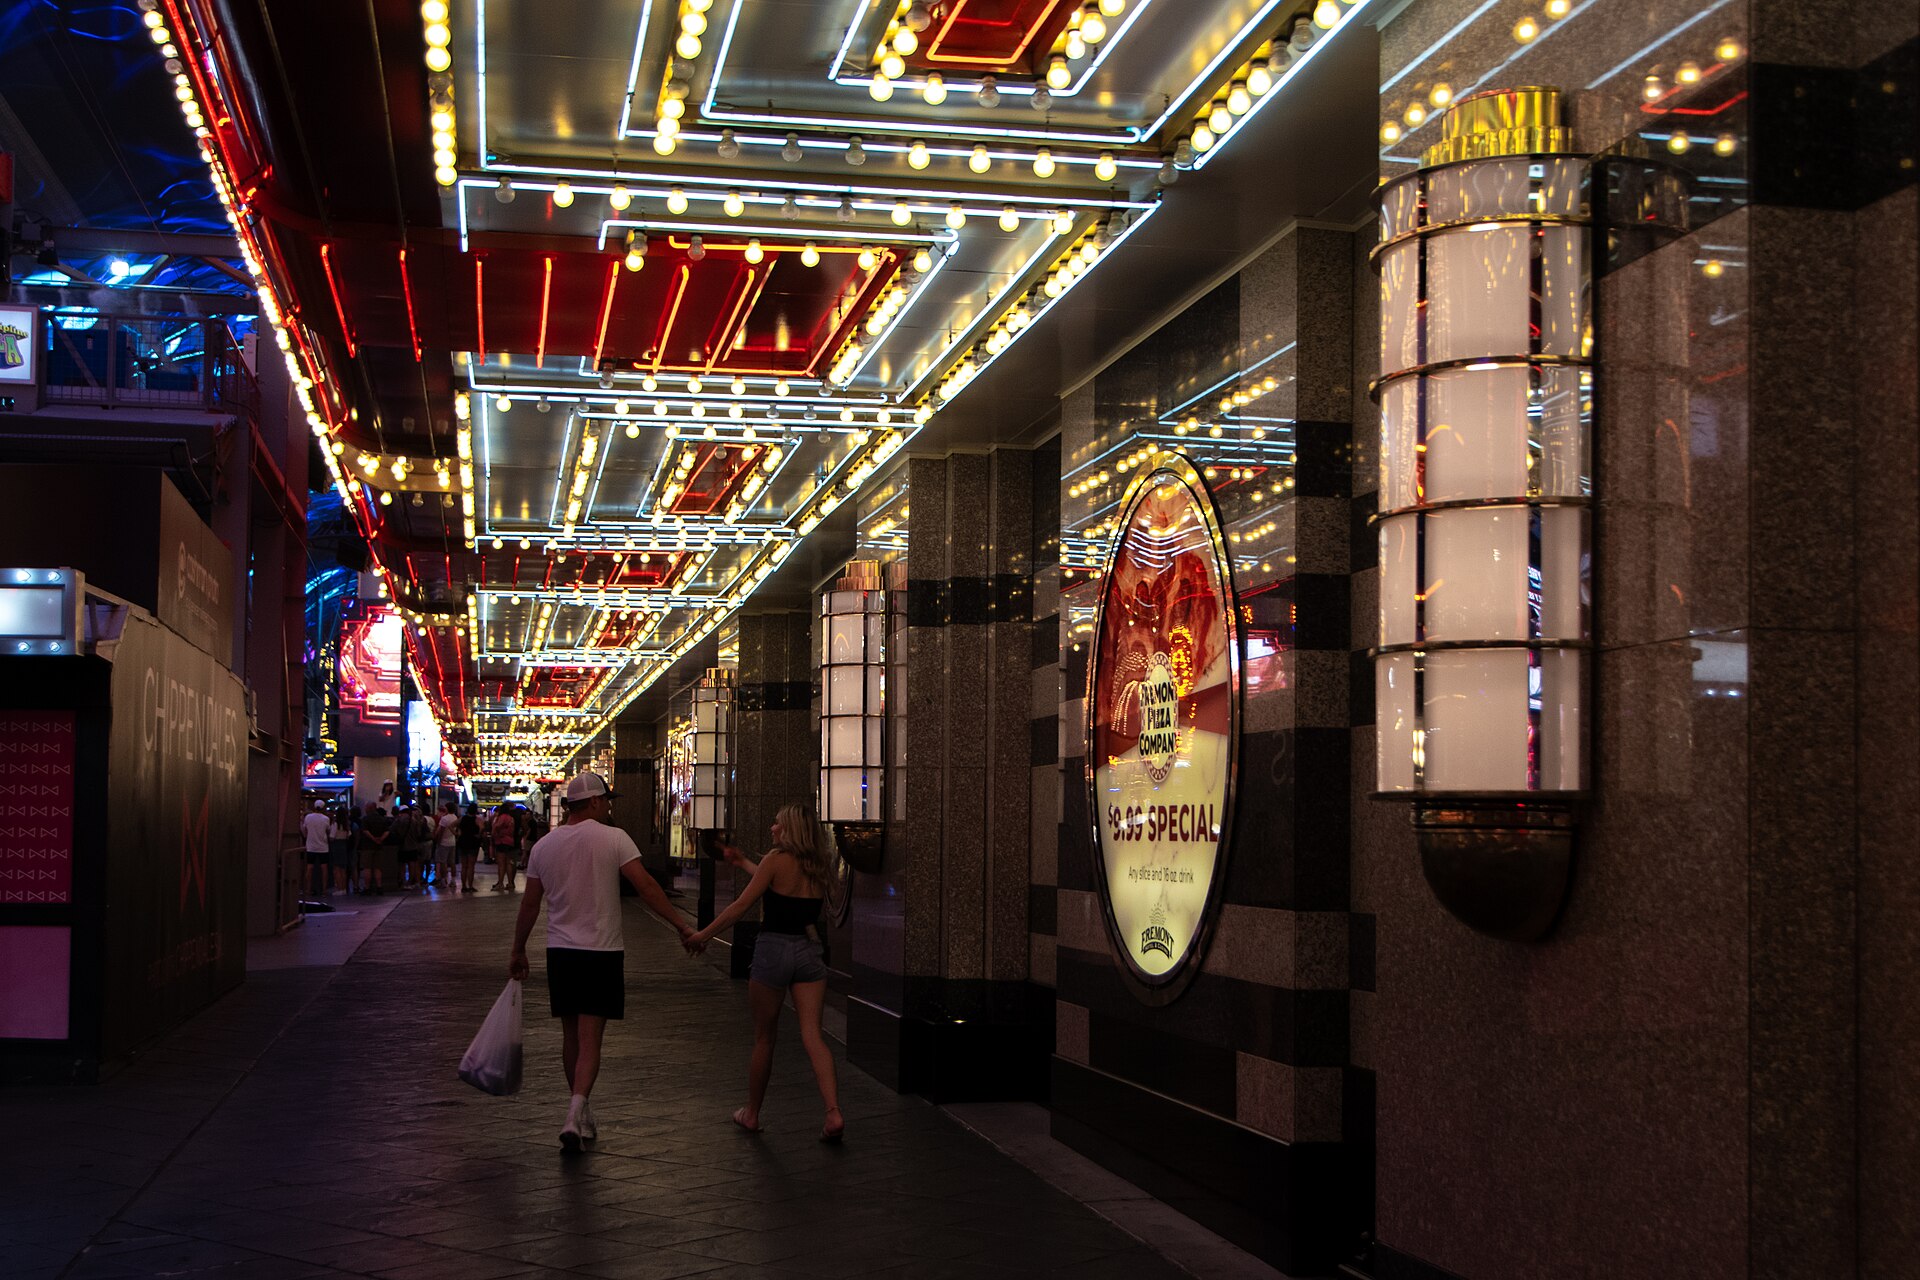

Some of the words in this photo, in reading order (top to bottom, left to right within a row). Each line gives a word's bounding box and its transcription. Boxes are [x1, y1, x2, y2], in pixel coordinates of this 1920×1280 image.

[143, 666, 237, 771] CHIPPENDALES
[1147, 707, 1171, 730] PIZZA
[1108, 802, 1143, 841] $9.99
[1148, 803, 1219, 842] SPECIAL
[1128, 865, 1138, 883] Any
[1139, 866, 1151, 881] slice
[1152, 866, 1162, 882] and
[1163, 867, 1169, 882] 16
[1179, 867, 1194, 884] drink
[1141, 925, 1175, 959] FREMONT
